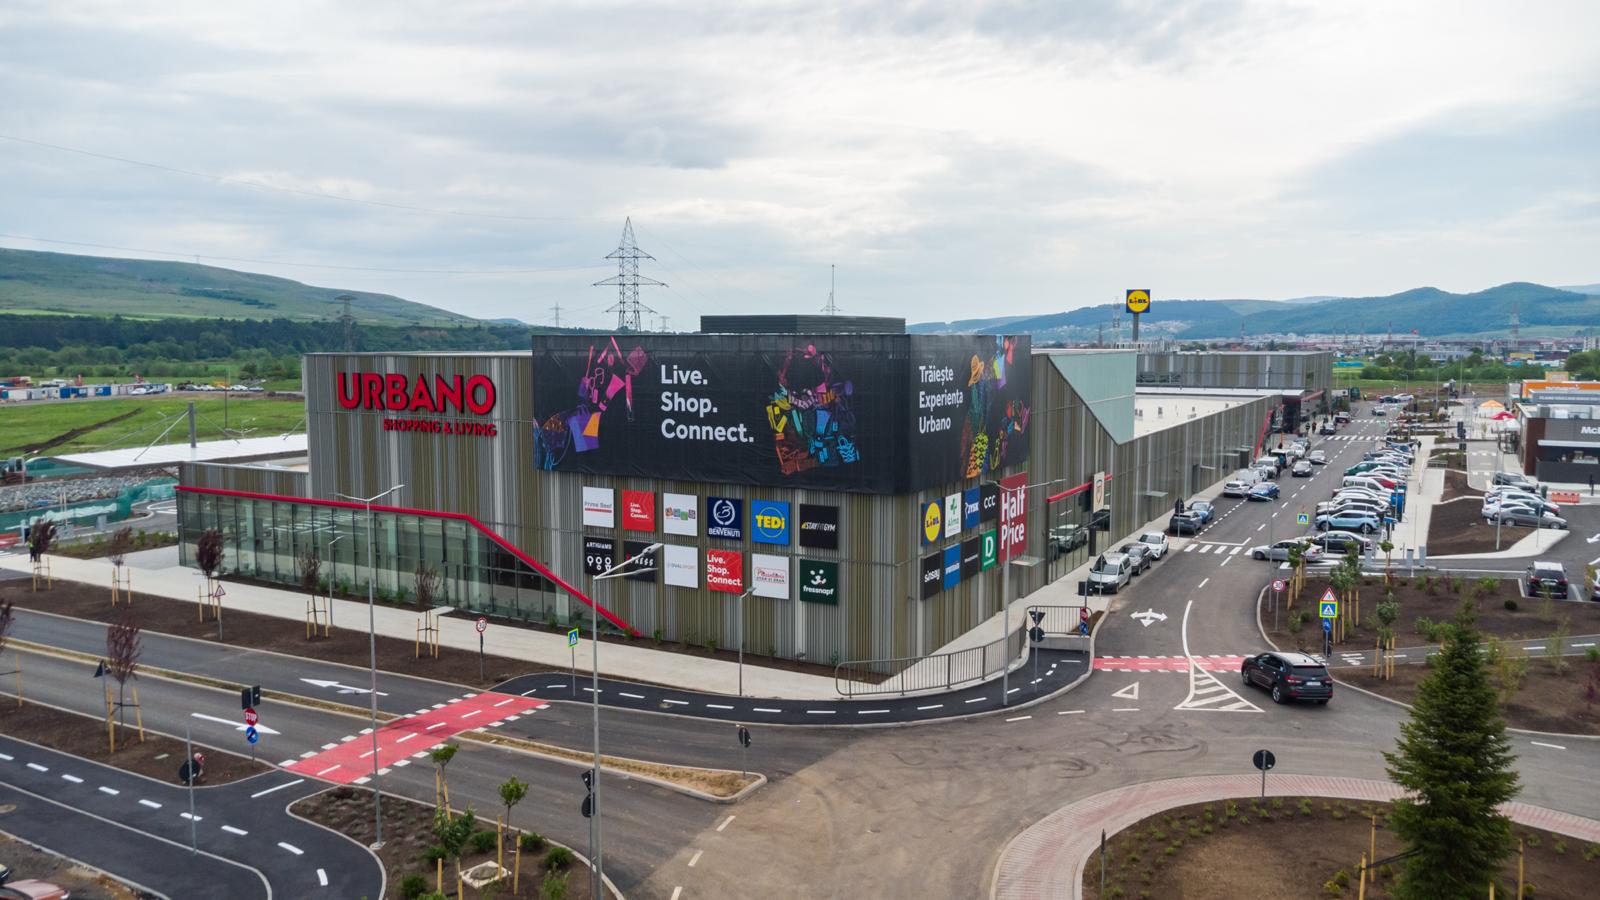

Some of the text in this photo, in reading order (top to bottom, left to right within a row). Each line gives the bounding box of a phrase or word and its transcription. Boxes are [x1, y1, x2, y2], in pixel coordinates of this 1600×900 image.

[661, 364, 708, 385] Live.
[919, 365, 954, 386] Trăiește
[337, 371, 497, 416] URBANO
[919, 389, 964, 412] Experiența
[661, 391, 718, 418] Shop.
[384, 418, 498, 437] SHOPPING & LIVING
[661, 418, 755, 443] Connect.
[919, 415, 952, 434] Urbano
[984, 495, 996, 509] CCC
[1001, 484, 1026, 522] Half
[756, 515, 785, 530] TEDi
[708, 527, 741, 538] BENVENUTI
[1001, 522, 1025, 550] Price
[986, 536, 994, 557] D
[707, 554, 726, 564] Live.
[707, 564, 730, 575] Shop.
[924, 568, 940, 583] sinsay
[707, 574, 743, 586] Connect.
[803, 585, 834, 596] fressnapf
